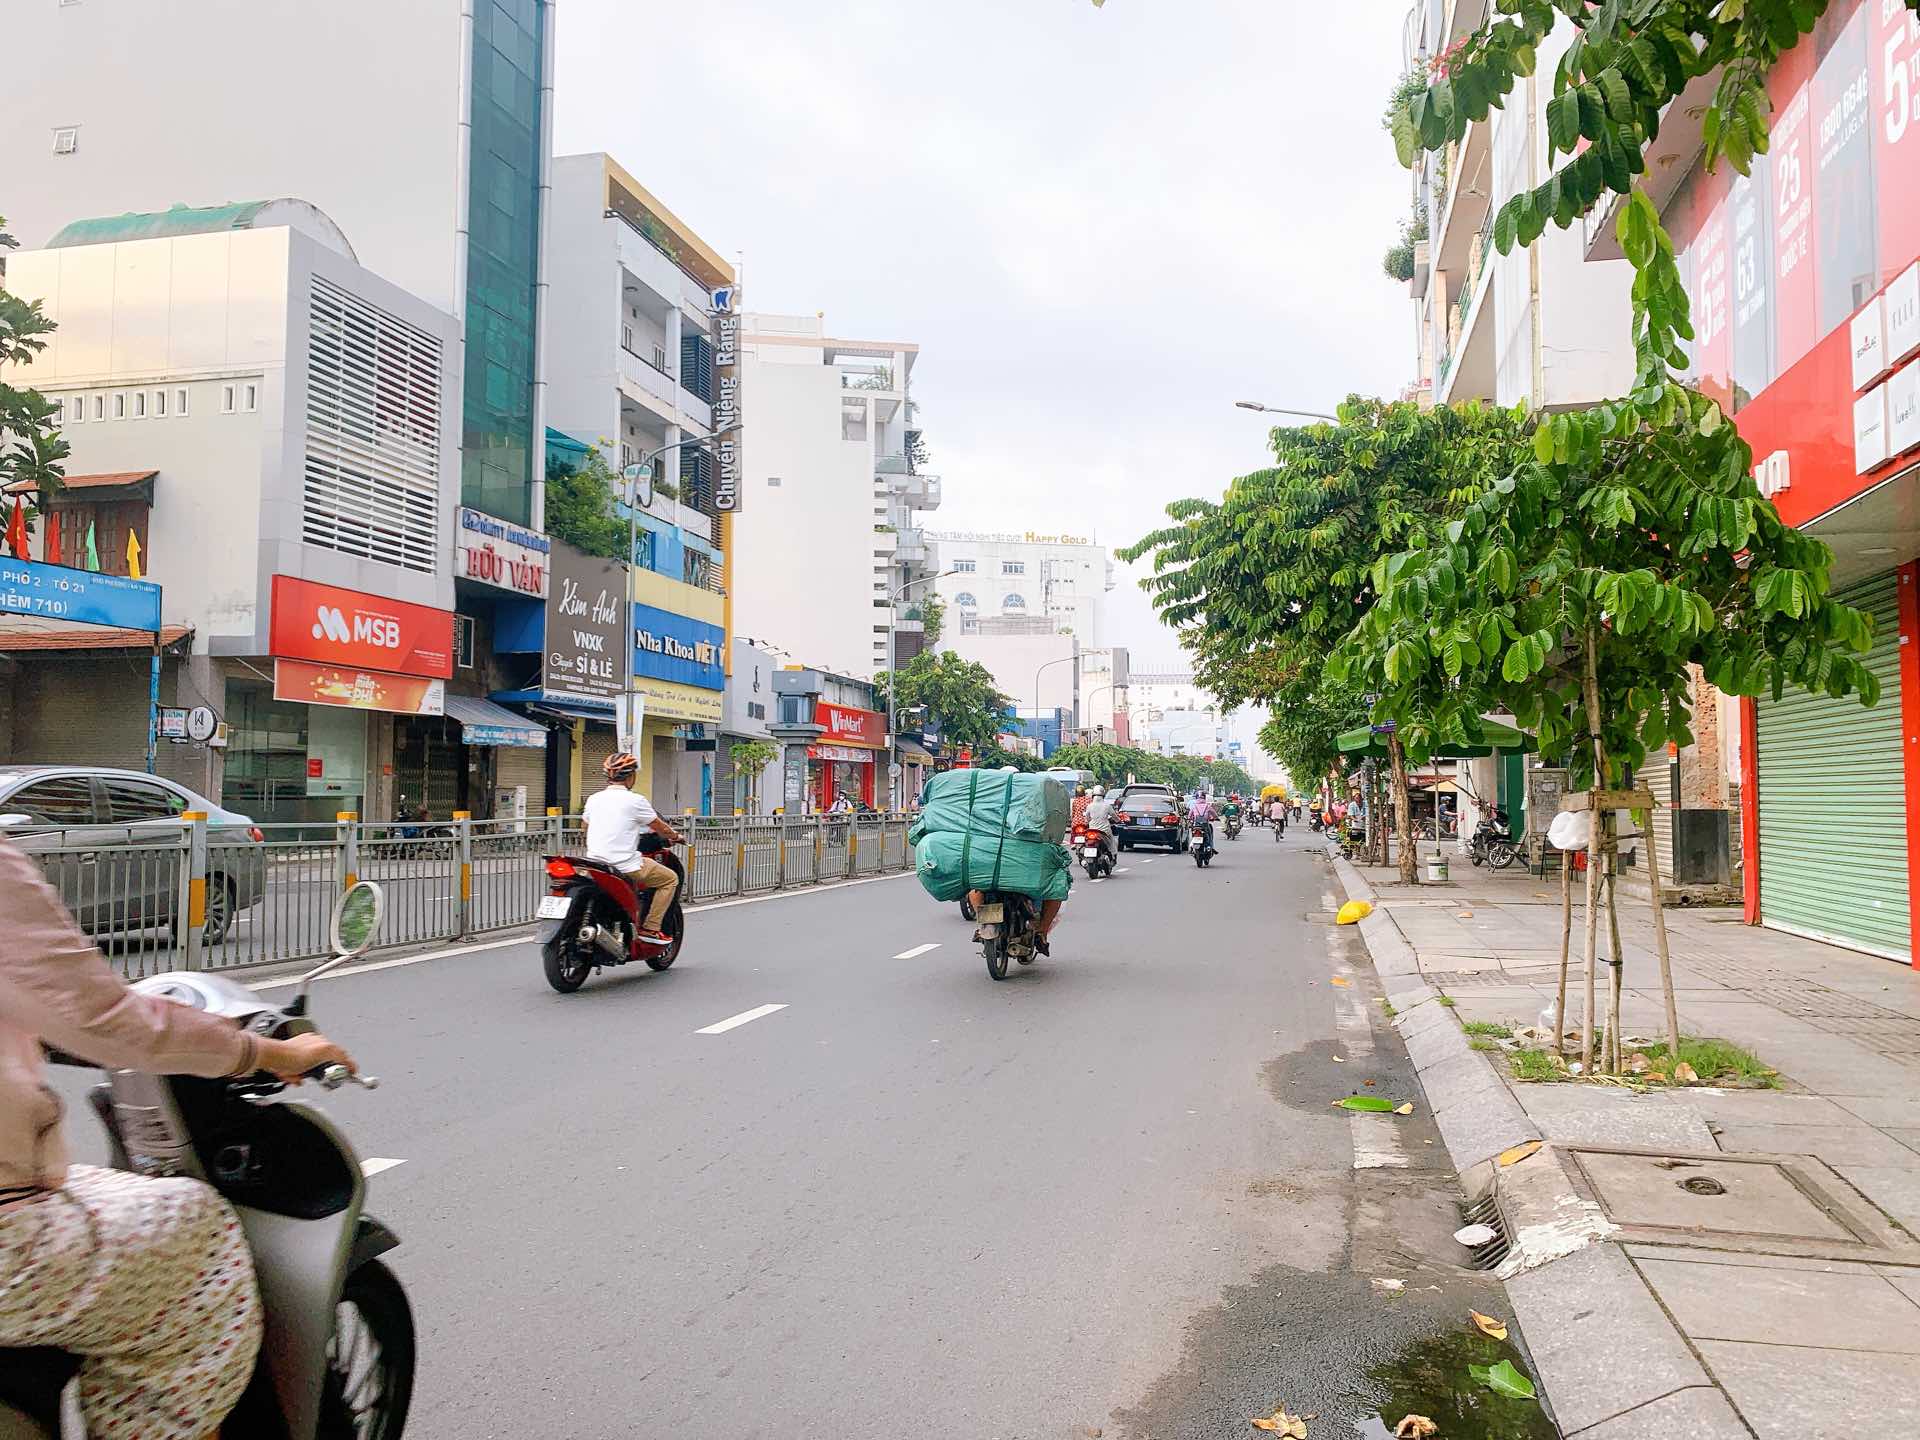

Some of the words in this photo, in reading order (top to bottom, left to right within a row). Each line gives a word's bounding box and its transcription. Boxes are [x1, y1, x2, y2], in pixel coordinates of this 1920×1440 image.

[715, 318, 737, 367] Răng
[716, 440, 735, 511] Chuyên
[3, 569, 30, 585] PHỐ
[34, 577, 41, 587] 2
[73, 583, 85, 593] 21
[559, 578, 587, 616] Kim
[592, 589, 616, 625] Anh
[354, 616, 399, 648] MSB
[573, 630, 604, 652] VNXK
[636, 630, 662, 653] Nha
[664, 635, 694, 660] Khoa
